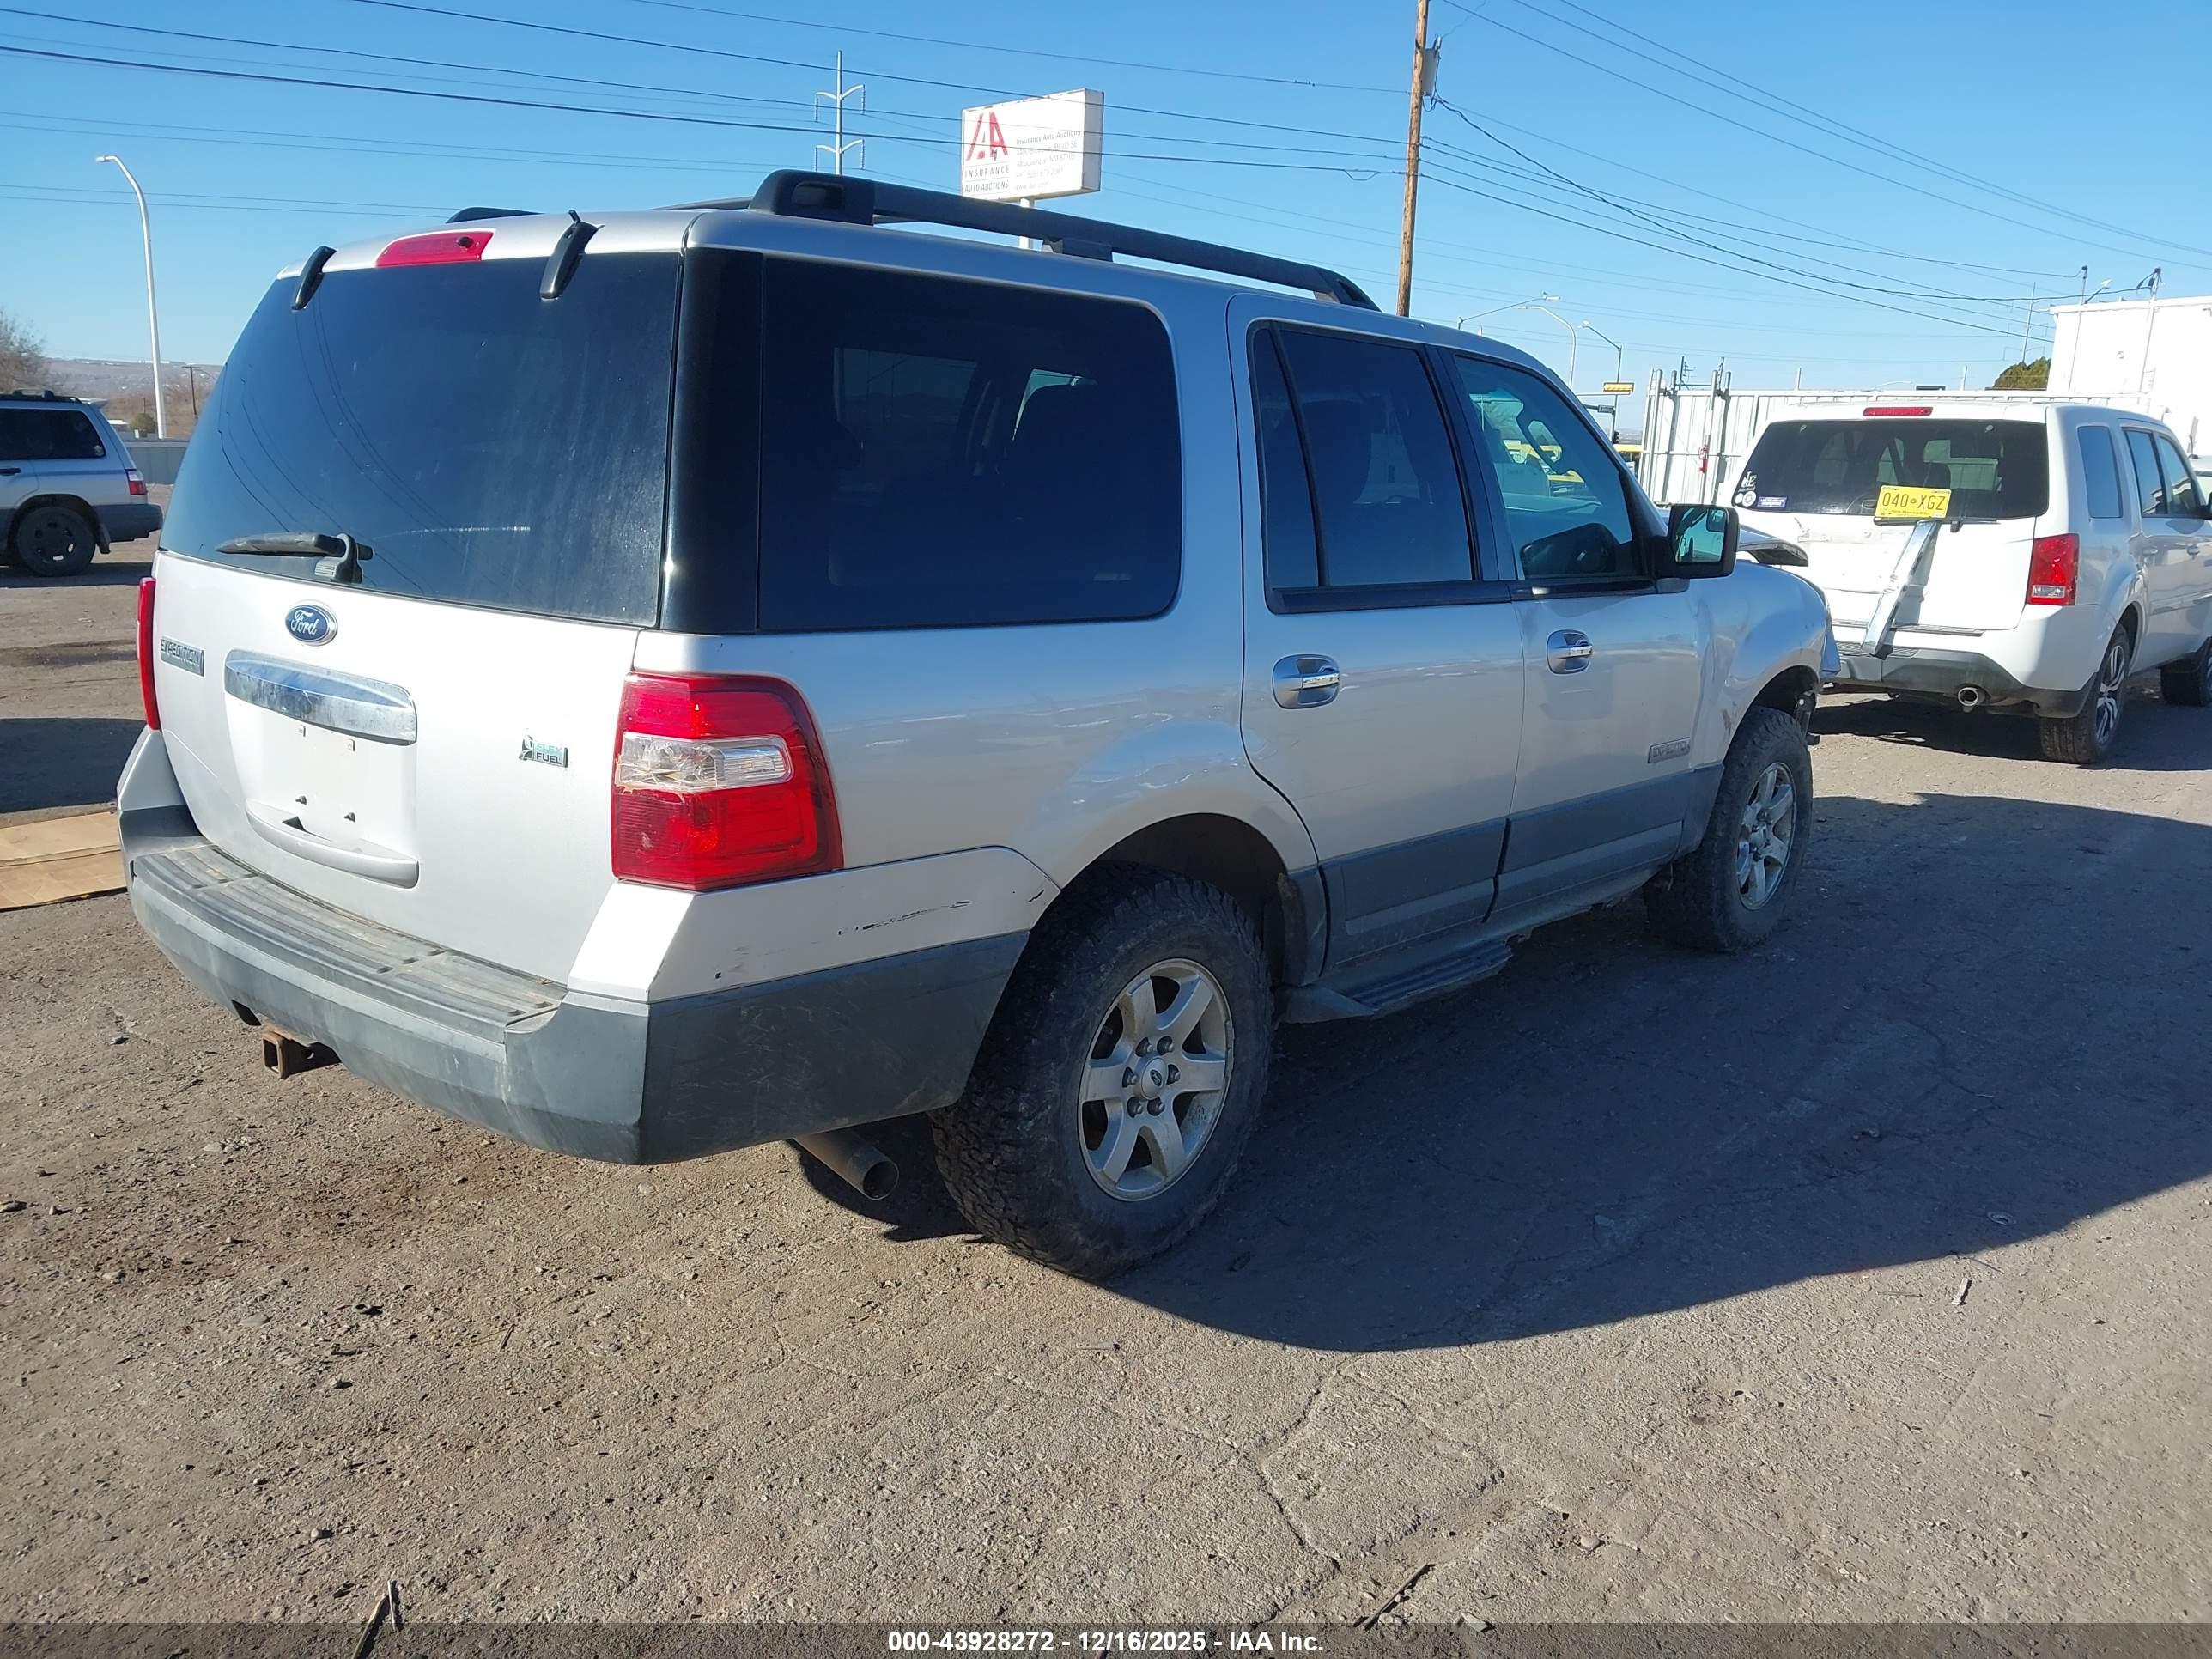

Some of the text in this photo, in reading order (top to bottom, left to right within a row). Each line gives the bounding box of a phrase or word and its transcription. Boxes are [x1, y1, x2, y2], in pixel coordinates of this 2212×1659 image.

[964, 164, 1010, 178] INSURANCE
[964, 183, 980, 193] AUTO
[981, 179, 1009, 191] AUCTIONS
[1881, 492, 1946, 511] 040 XGZ
[290, 609, 320, 635] Ford
[161, 638, 199, 665] EXPEDITION
[536, 752, 562, 765] FUEL
